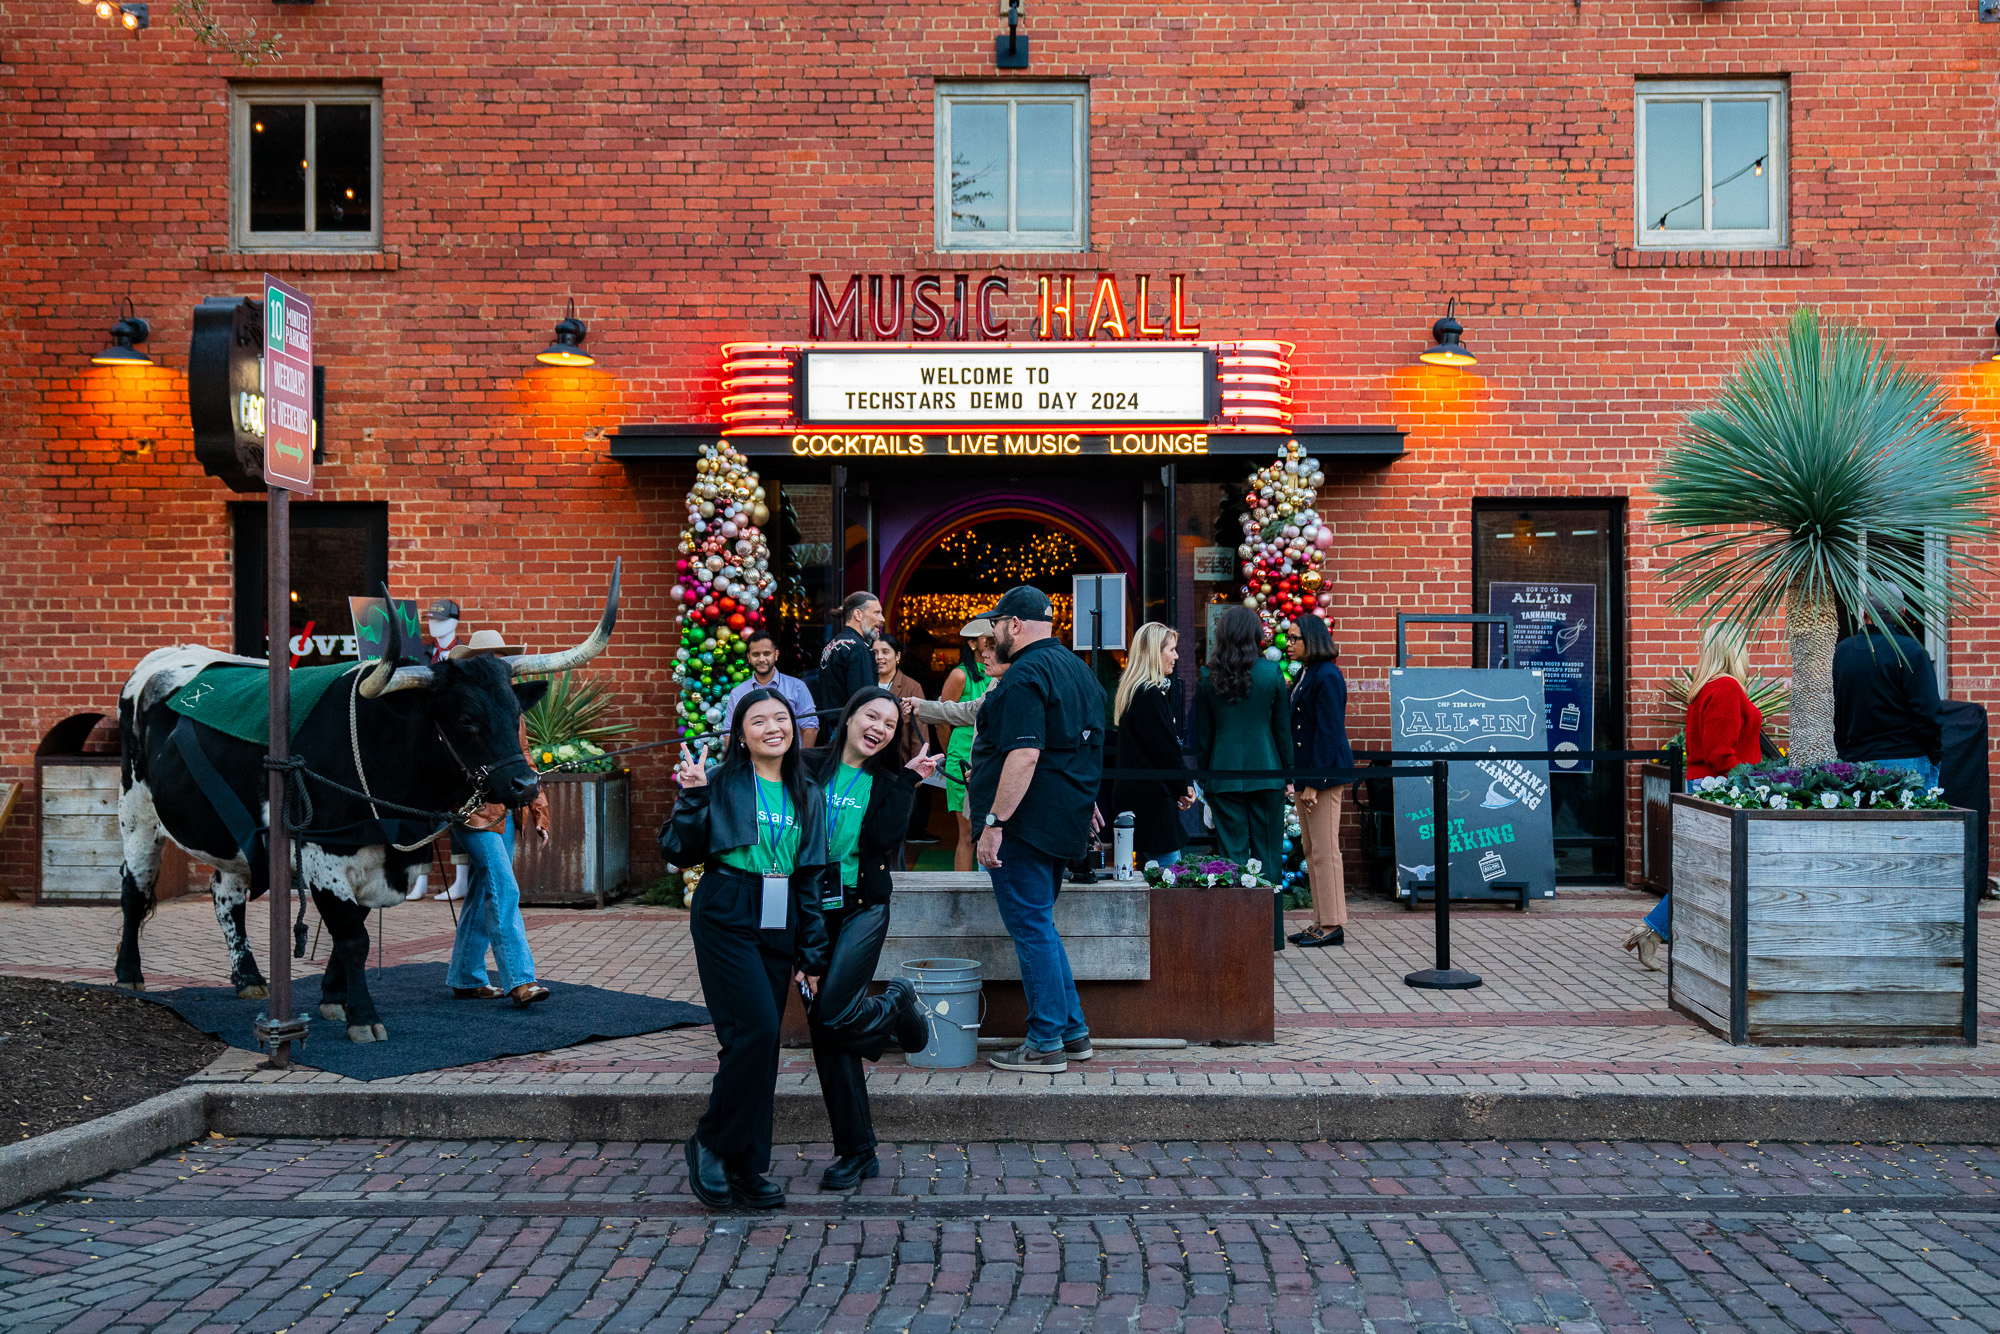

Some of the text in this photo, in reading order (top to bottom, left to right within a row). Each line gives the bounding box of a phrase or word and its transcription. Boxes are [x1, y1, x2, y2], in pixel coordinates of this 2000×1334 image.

[809, 272, 1200, 340] MUSIC HALL
[270, 298, 283, 341] 10
[285, 306, 308, 333] MINUTE
[285, 325, 308, 352] PARKING
[273, 360, 306, 398] WEEKDAYS
[920, 367, 1049, 385] WELCOME TO
[845, 392, 1139, 410] TECHSTARS DEMO DAY 2024
[270, 397, 276, 425] &
[277, 399, 308, 436] WEEKENDS
[792, 433, 1209, 455] COCKTAILS LIVE MUSIC LOUNGE
[1511, 592, 1573, 605] ALL IN
[1520, 610, 1567, 621] TANNAHILL'S
[265, 634, 360, 657] OVE
[1406, 711, 1469, 732] ALL
[1481, 714, 1527, 732] IN
[1418, 817, 1465, 841] ST
[1447, 822, 1516, 854] AKING
